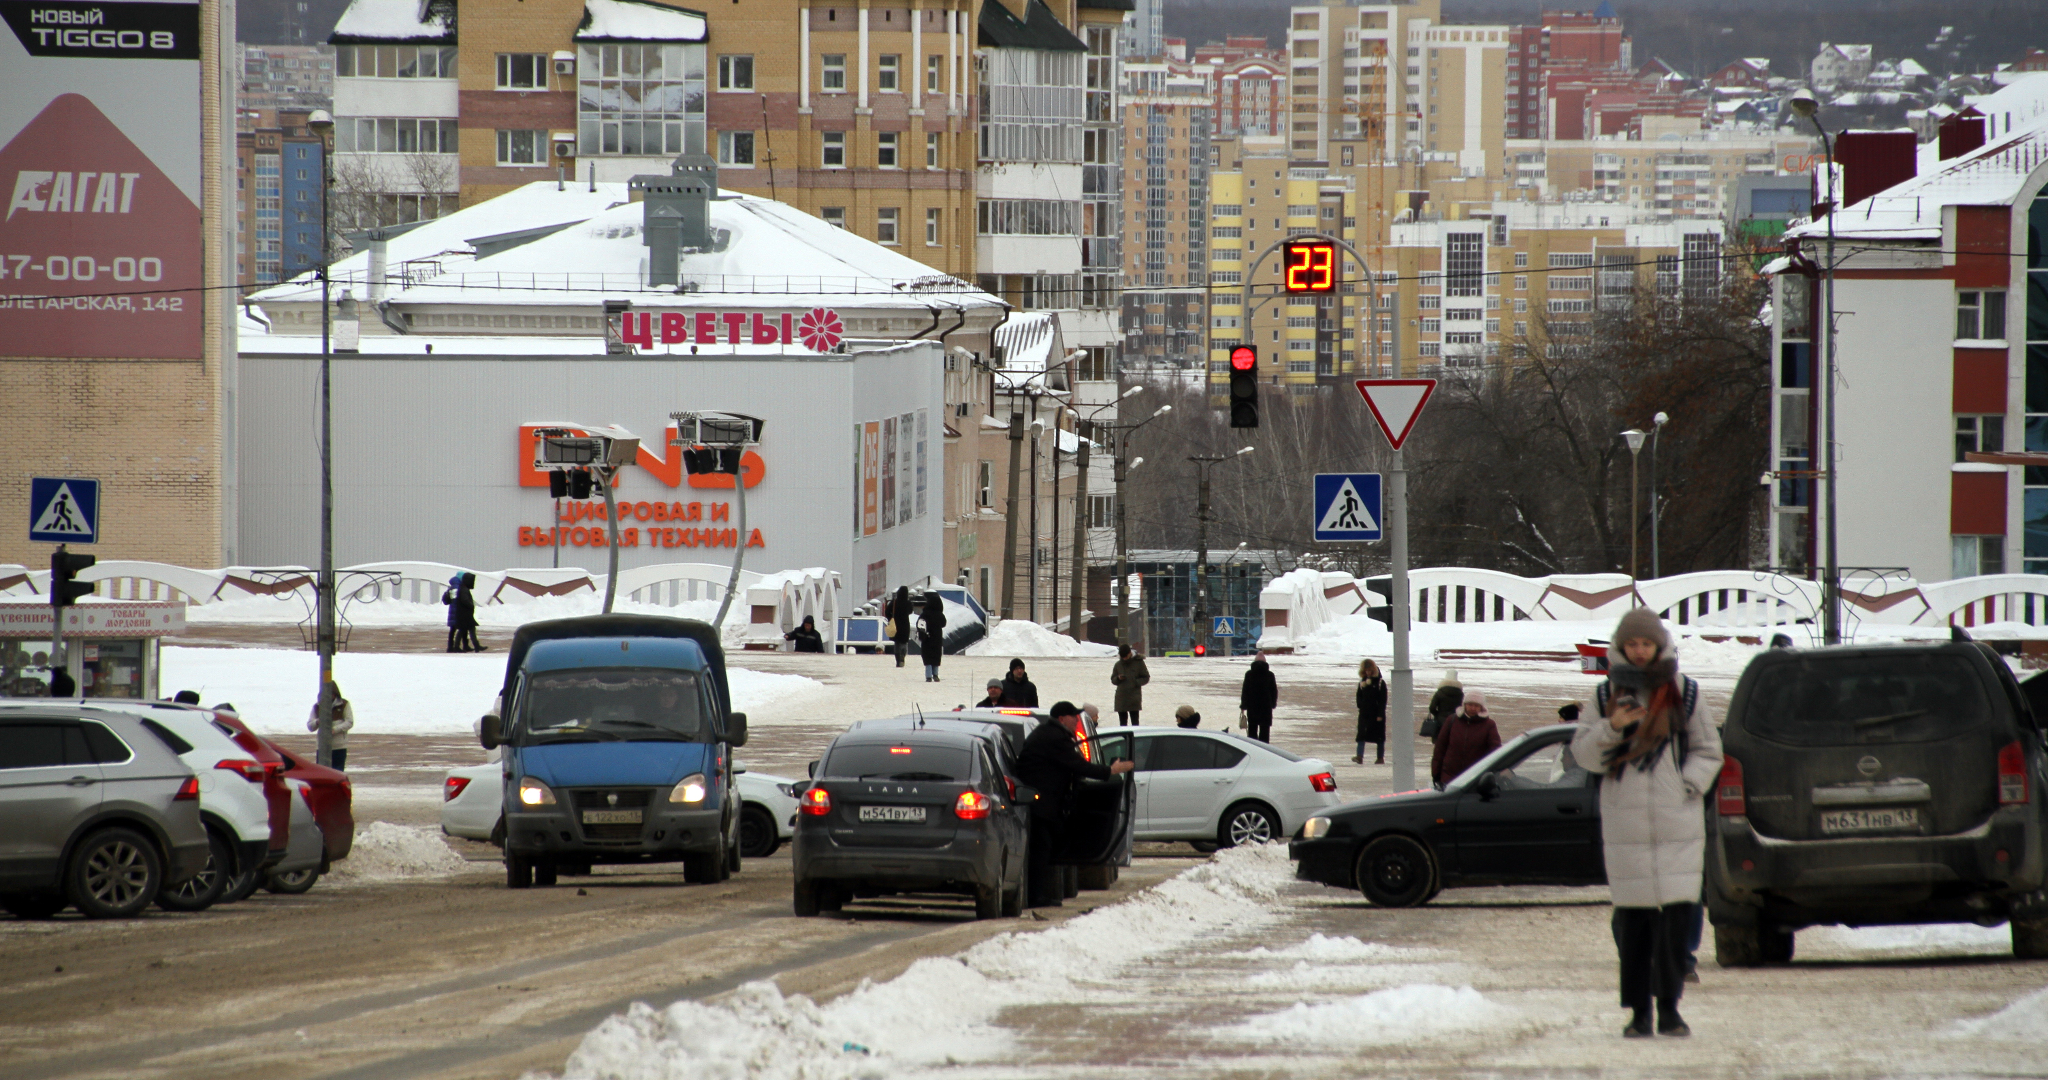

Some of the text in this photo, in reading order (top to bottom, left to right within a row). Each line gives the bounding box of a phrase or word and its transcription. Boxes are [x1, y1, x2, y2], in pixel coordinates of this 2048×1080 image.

[30, 8, 104, 25] НОВЫЙ
[30, 28, 175, 50] TIGGO 8
[1288, 246, 1333, 290] 23
[142, 296, 184, 312] 142
[621, 312, 793, 350] ЦВЕТЫ
[711, 501, 729, 523] И
[111, 609, 146, 619] ТОВАРЫ
[868, 786, 918, 794] LADA
